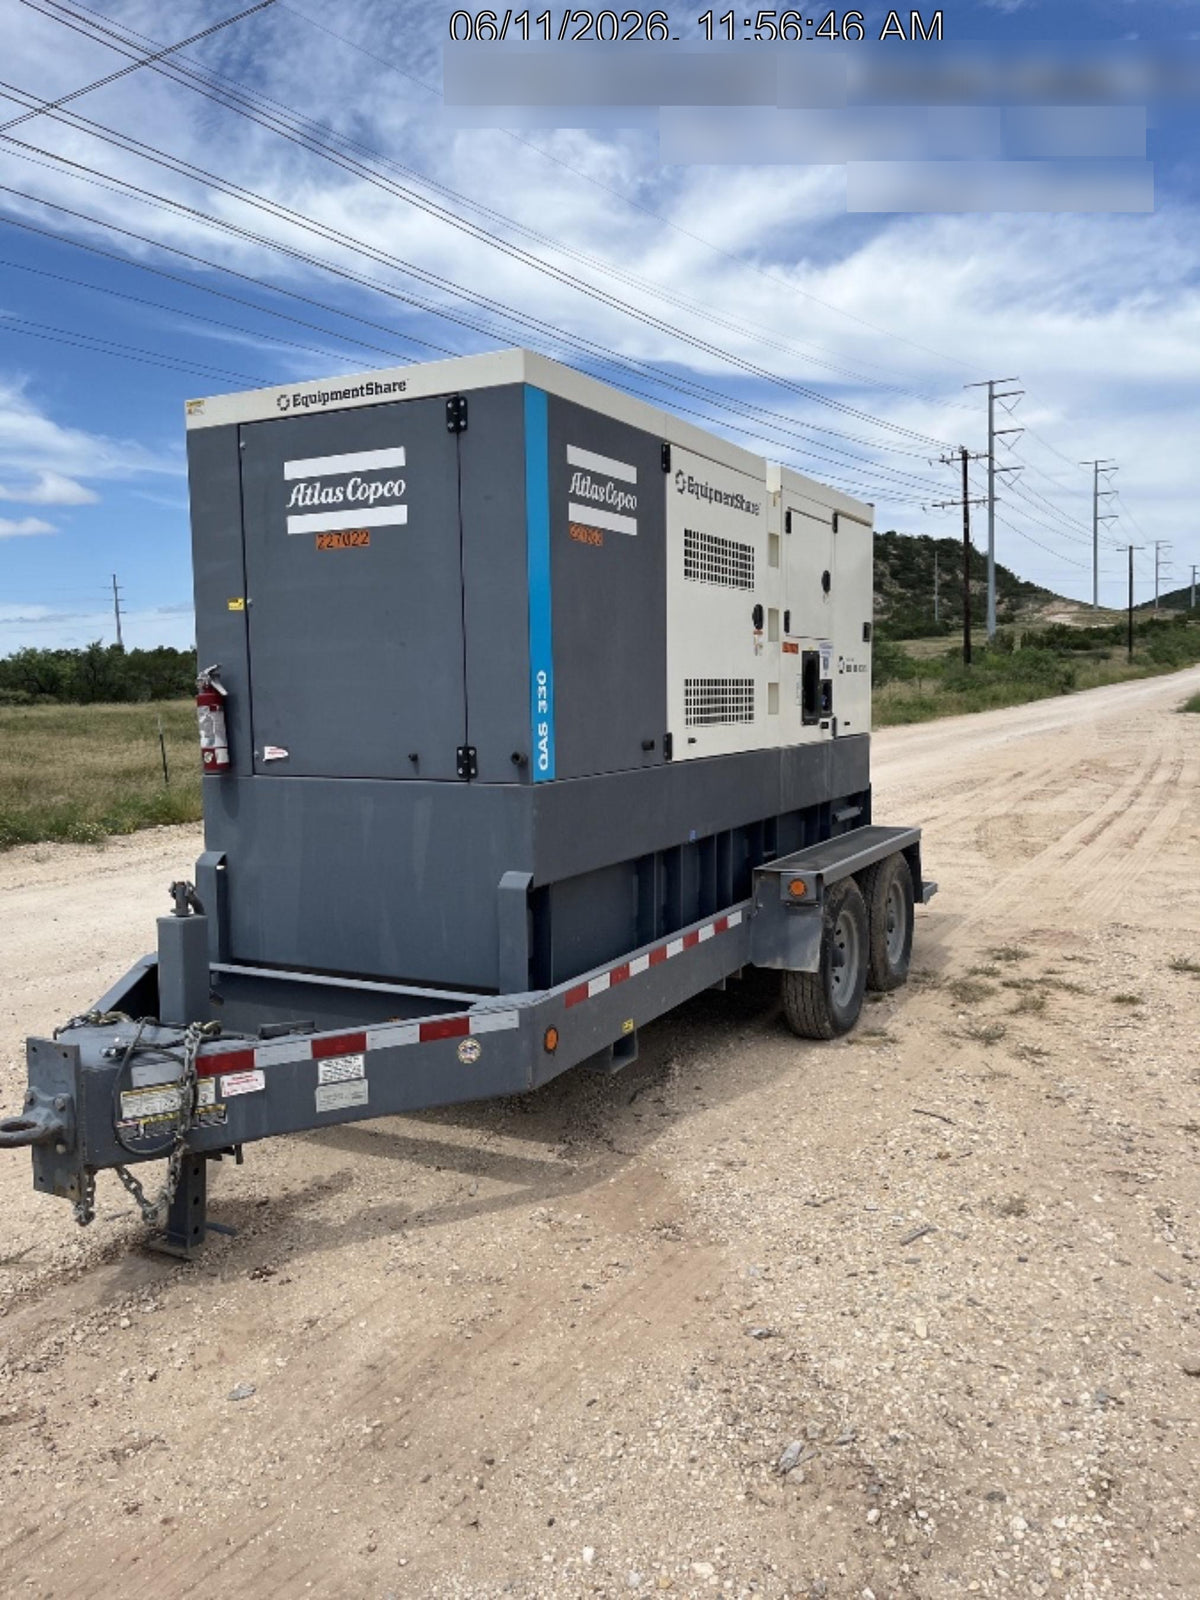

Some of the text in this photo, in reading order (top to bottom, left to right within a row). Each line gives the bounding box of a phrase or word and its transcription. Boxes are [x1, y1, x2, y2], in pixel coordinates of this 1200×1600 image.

[292, 380, 407, 408] EquipmentShare
[285, 477, 407, 508] Atlas Copco
[568, 472, 638, 511] Atlas Copco
[687, 475, 760, 517] EquipmentShare
[317, 531, 369, 550] 227022
[536, 669, 548, 714] 330
